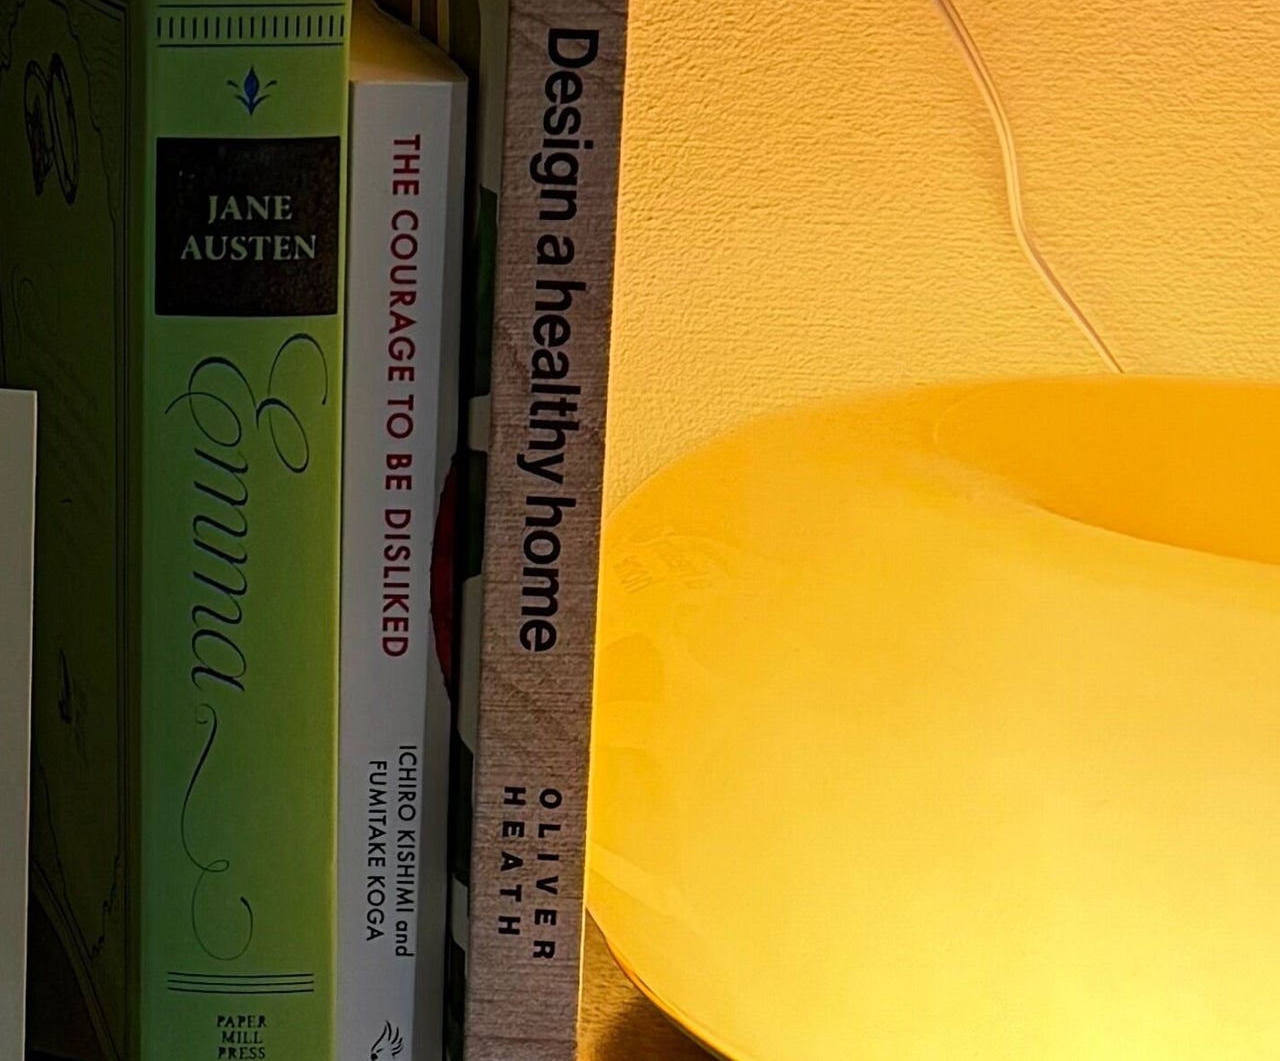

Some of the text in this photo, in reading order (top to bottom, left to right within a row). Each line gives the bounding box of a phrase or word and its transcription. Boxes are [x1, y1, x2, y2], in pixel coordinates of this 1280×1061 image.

[180, 233, 318, 263] AUSTEN
[207, 194, 293, 224] JANE
[380, 134, 422, 658] THE COURAGE TO BE DISLIKED
[516, 27, 601, 653] Design a healthy home
[164, 332, 329, 693] Emma
[366, 760, 388, 941] FUMITAKE KOGA
[395, 745, 418, 957] ICHIRO KISHIMI and
[496, 786, 527, 937] HEATH
[531, 787, 563, 960] OLIVER
[216, 1014, 268, 1029] PAPER
[218, 1046, 266, 1061] PRESS
[221, 1030, 263, 1045] MILL
